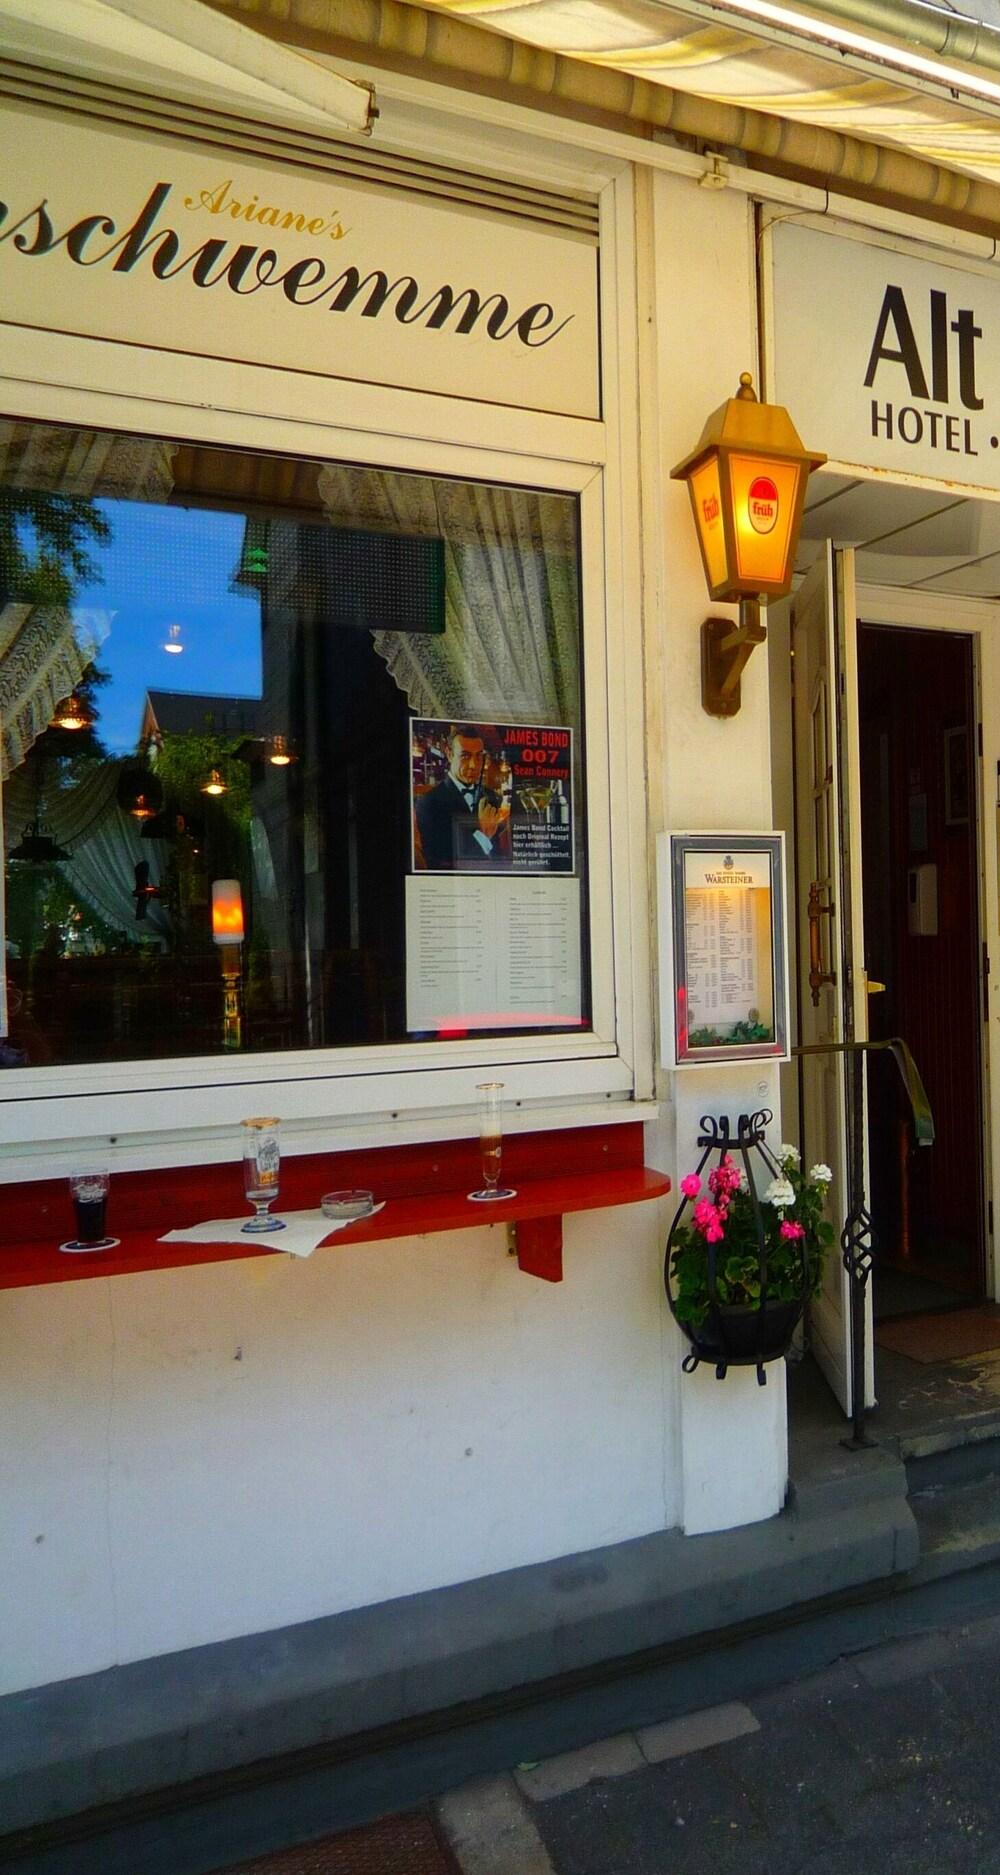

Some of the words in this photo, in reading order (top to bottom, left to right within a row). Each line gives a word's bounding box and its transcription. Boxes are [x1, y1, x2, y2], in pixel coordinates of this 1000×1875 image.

[863, 284, 984, 411] Alt
[871, 400, 978, 456] HOTEL
[752, 501, 773, 517] früh
[504, 729, 538, 746] JAMES
[541, 731, 568, 748] BOND
[522, 748, 560, 764] 007
[513, 764, 534, 776] Sean
[536, 765, 569, 779] Connery
